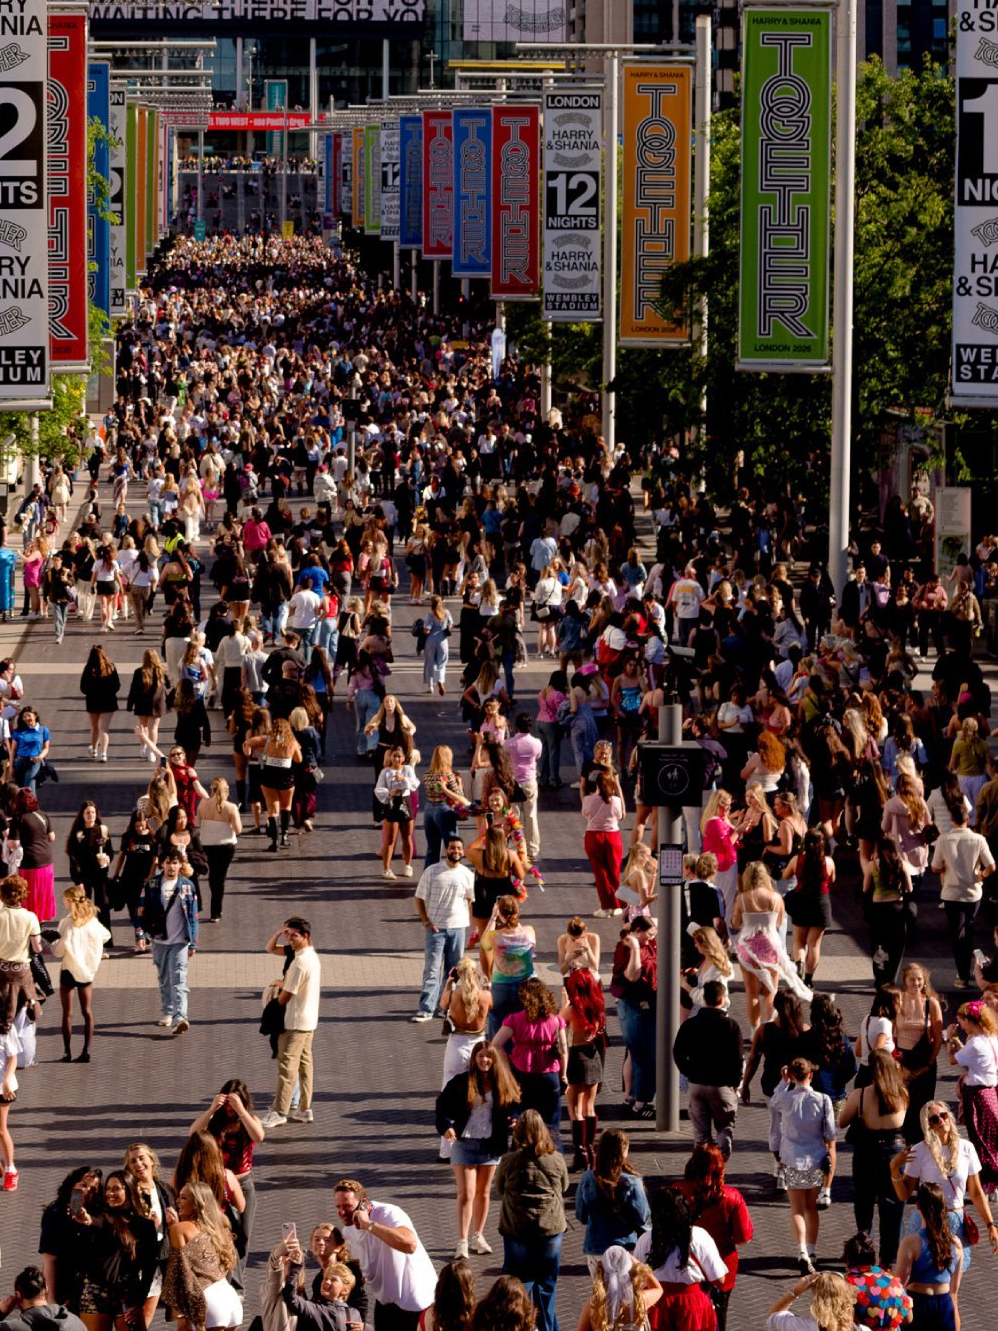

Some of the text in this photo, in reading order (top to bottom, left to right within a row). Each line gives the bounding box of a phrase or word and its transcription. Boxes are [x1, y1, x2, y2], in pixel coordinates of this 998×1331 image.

[789, 17, 822, 26] SHANIA
[548, 96, 599, 107] LONDON
[552, 130, 594, 139] HARRY
[757, 32, 817, 338] TOGETHER
[460, 119, 489, 263] TOGETHER
[547, 173, 597, 215] 12
[501, 117, 533, 283] TOGETHER
[548, 216, 597, 228] NIGHTS
[551, 251, 593, 261] HARRY
[547, 294, 598, 302] WEMBLEY
[547, 302, 598, 310] STADIUM
